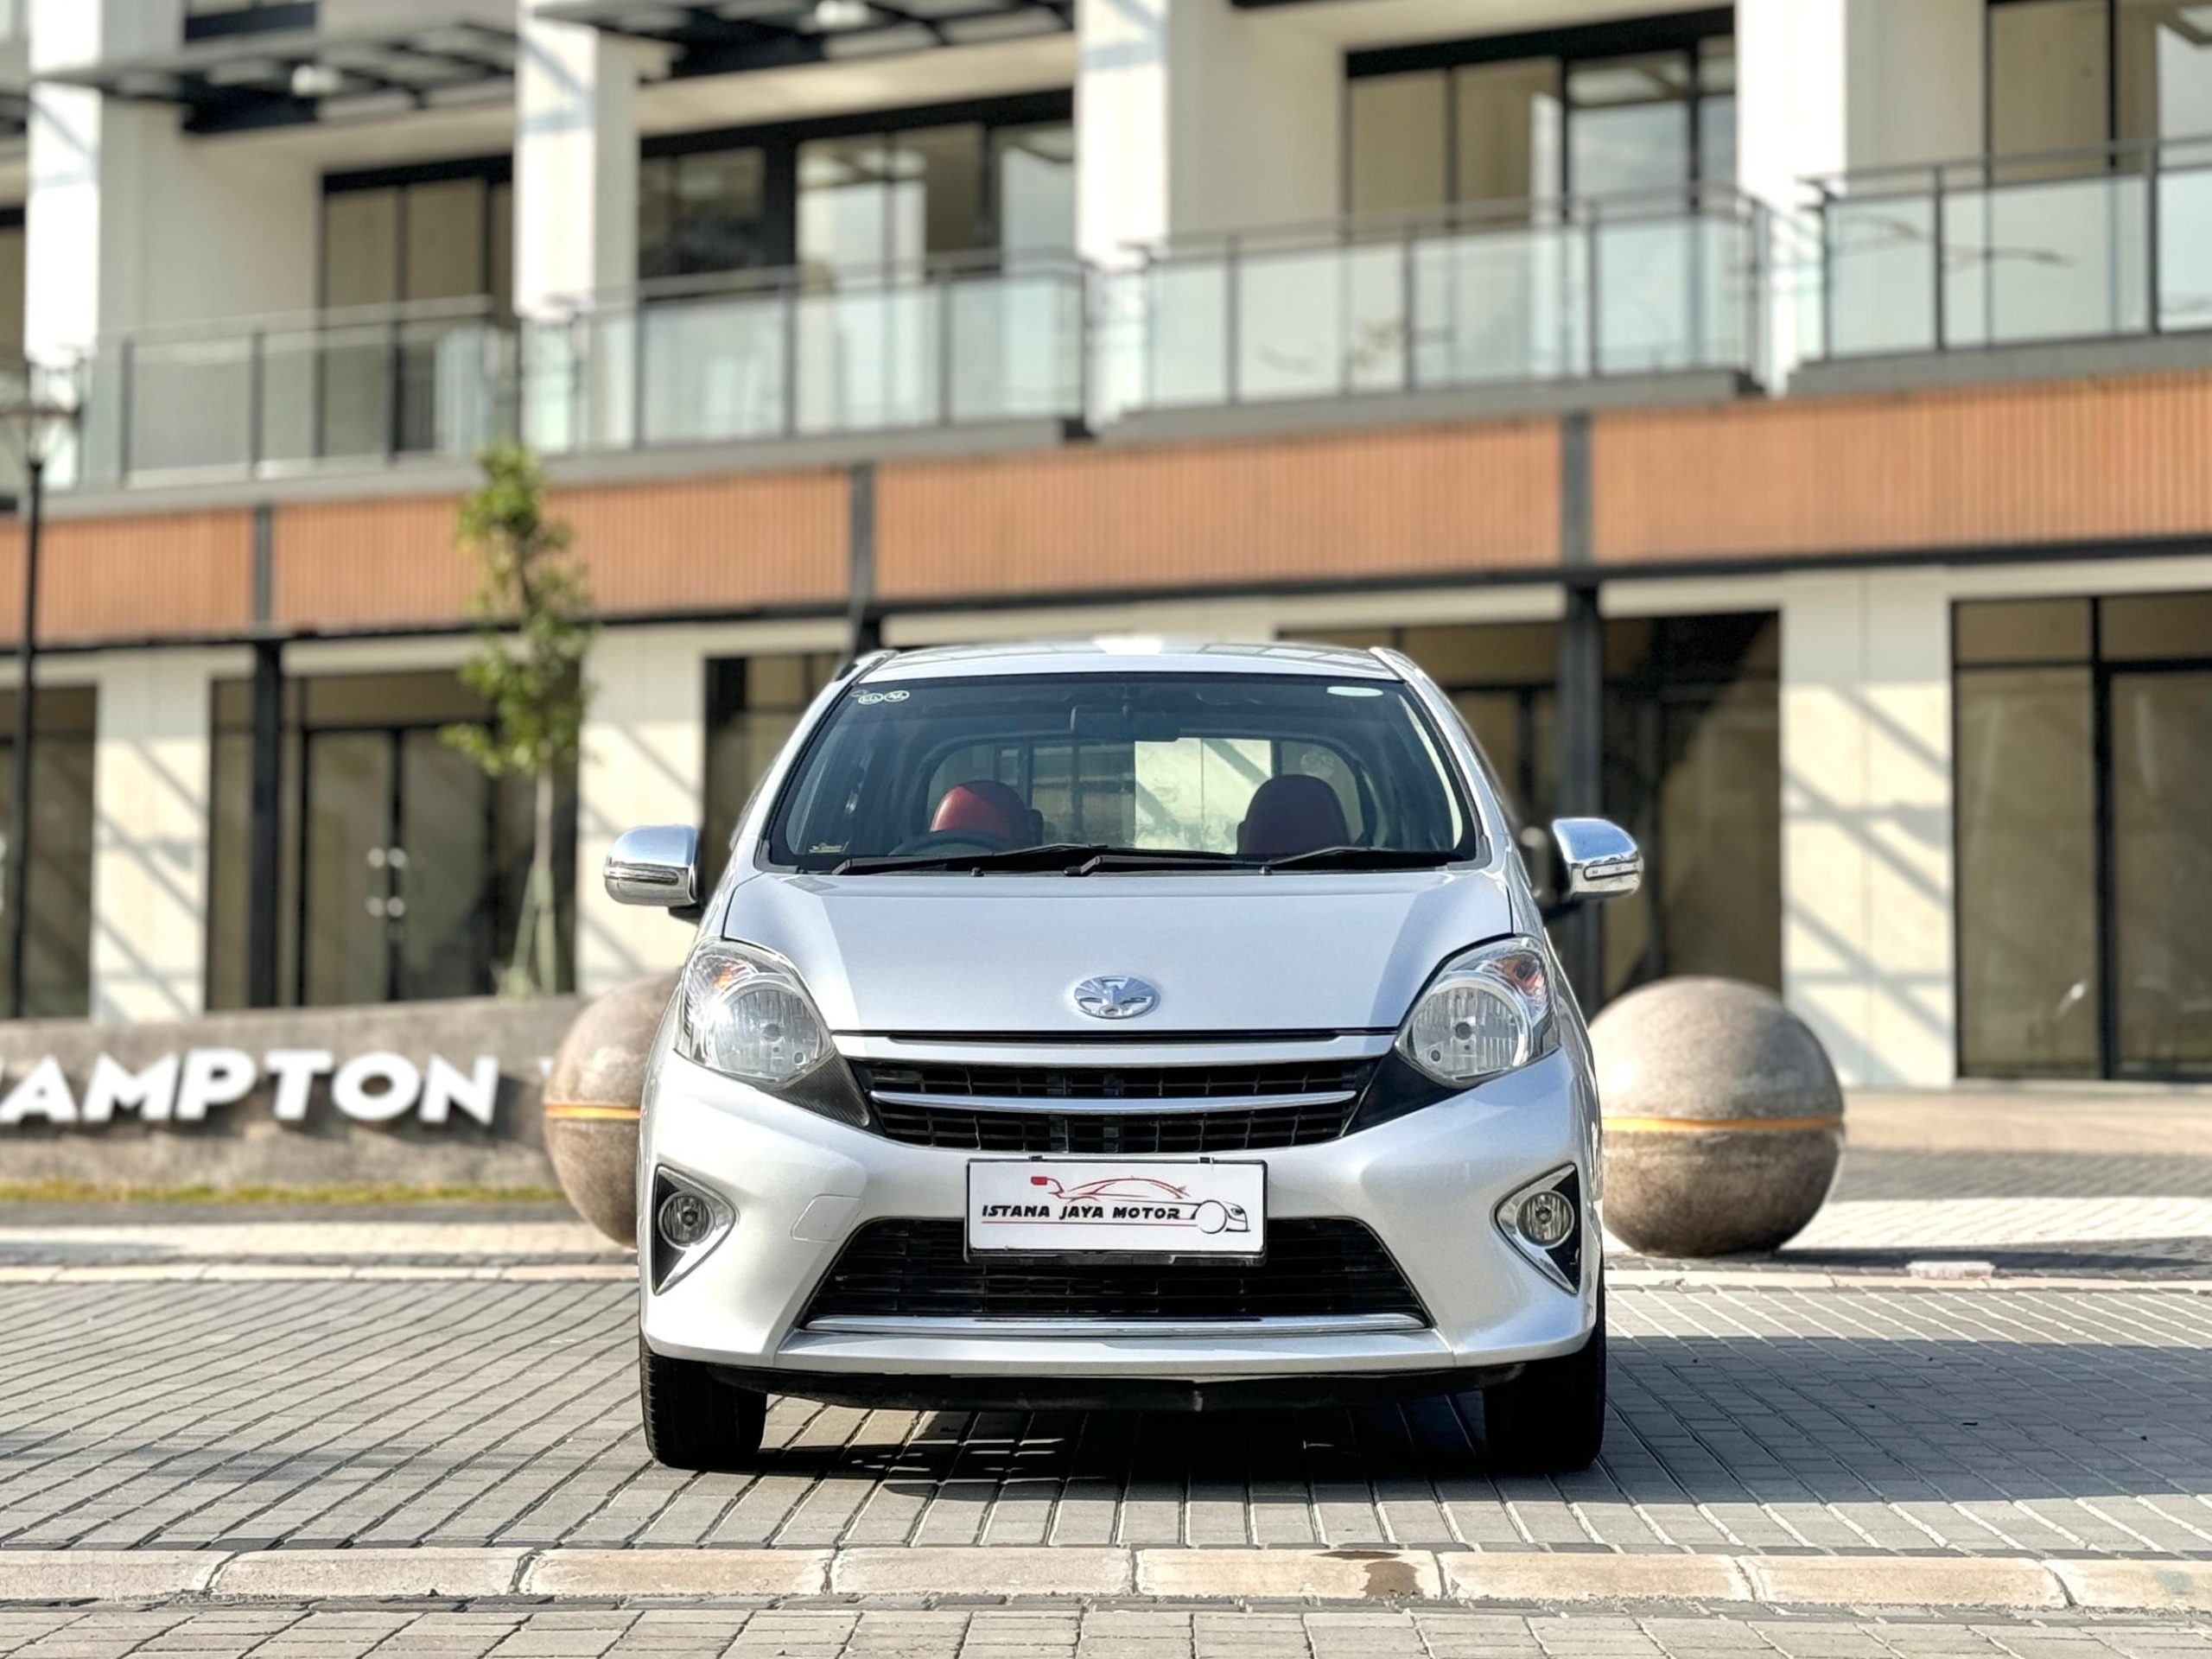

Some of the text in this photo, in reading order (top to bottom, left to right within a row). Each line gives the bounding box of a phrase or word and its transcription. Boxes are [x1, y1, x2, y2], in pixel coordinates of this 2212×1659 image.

[0, 1047, 499, 1125] AMPTON
[982, 1205, 1180, 1220] ISTANA JAYA MOTOR
